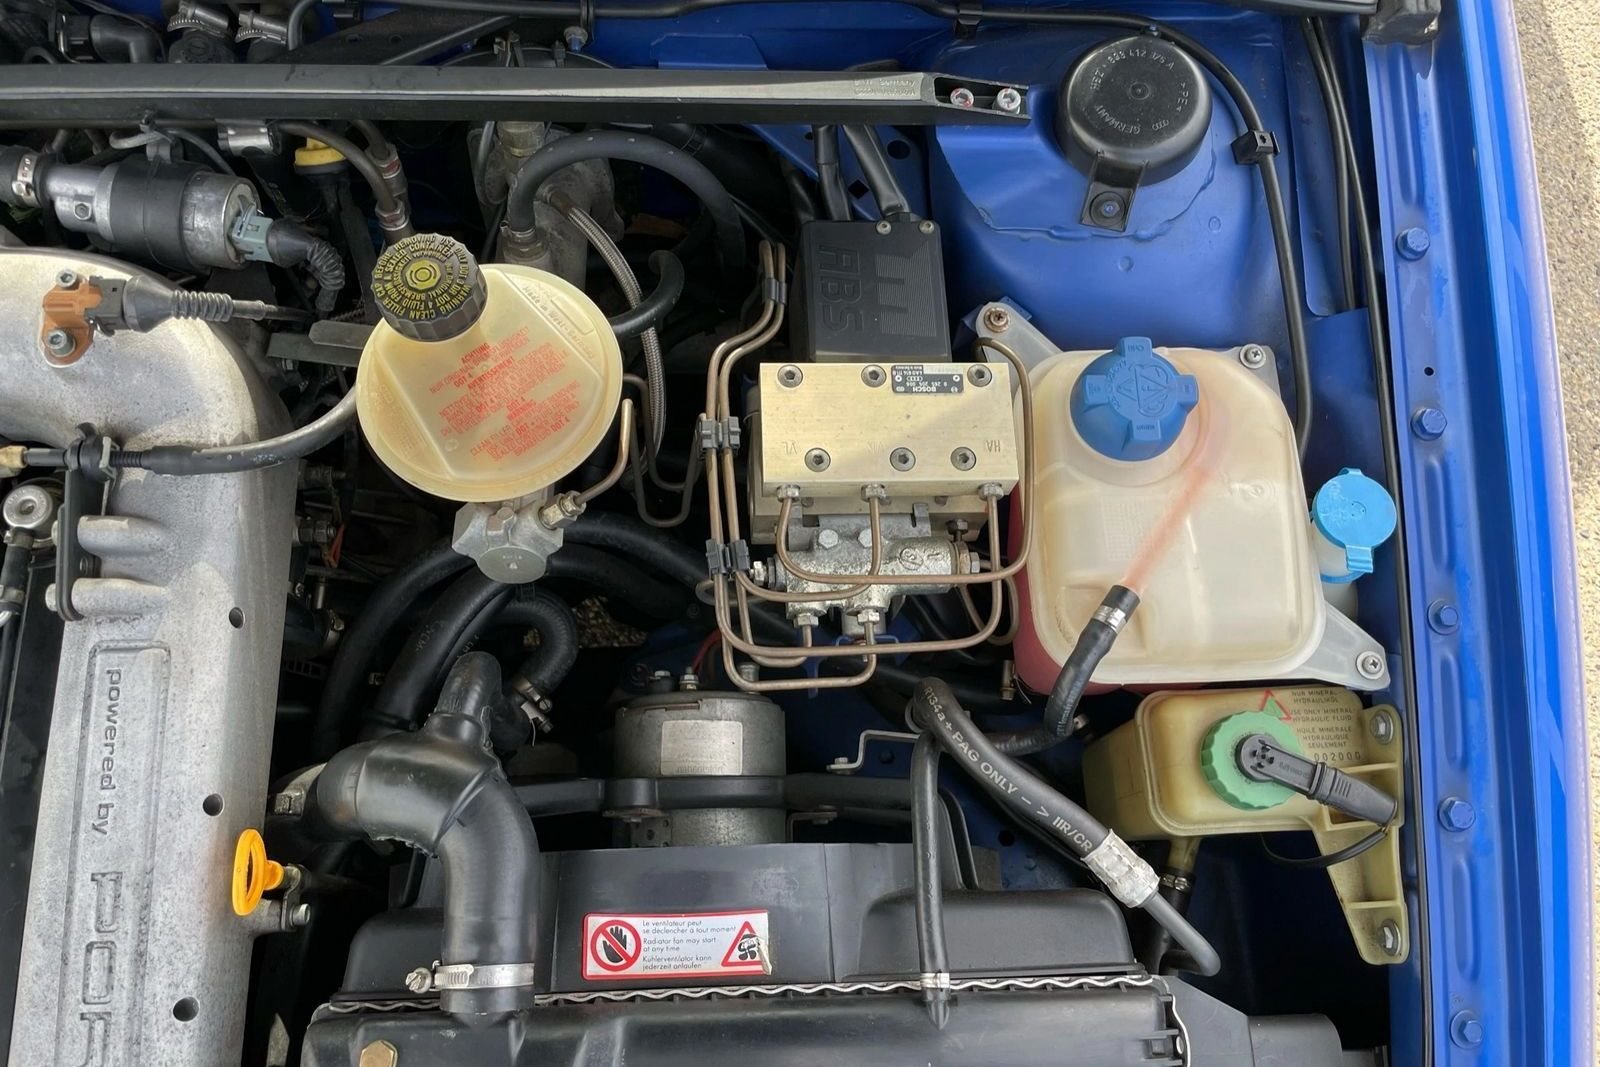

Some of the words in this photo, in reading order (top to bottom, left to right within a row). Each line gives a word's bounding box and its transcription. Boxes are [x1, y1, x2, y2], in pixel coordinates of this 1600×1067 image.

[1096, 104, 1140, 134] GERMANY
[409, 242, 454, 257] CONTAINER
[385, 250, 407, 272] SEALED
[819, 245, 863, 335] ABS
[383, 298, 405, 315] FILLER
[402, 298, 425, 310] FLUID
[436, 295, 450, 307] DOT
[409, 310, 436, 319] CLEAN
[459, 341, 490, 364] ACHTUNG
[465, 355, 516, 390] AVERTISSEMENT
[986, 440, 1001, 453] HA
[100, 668, 124, 790] powered
[924, 686, 946, 722] R134a
[951, 731, 980, 762] PAG
[980, 762, 1019, 794] ONLY
[1314, 752, 1360, 761] 002000
[92, 802, 116, 836] by
[686, 938, 700, 946] may
